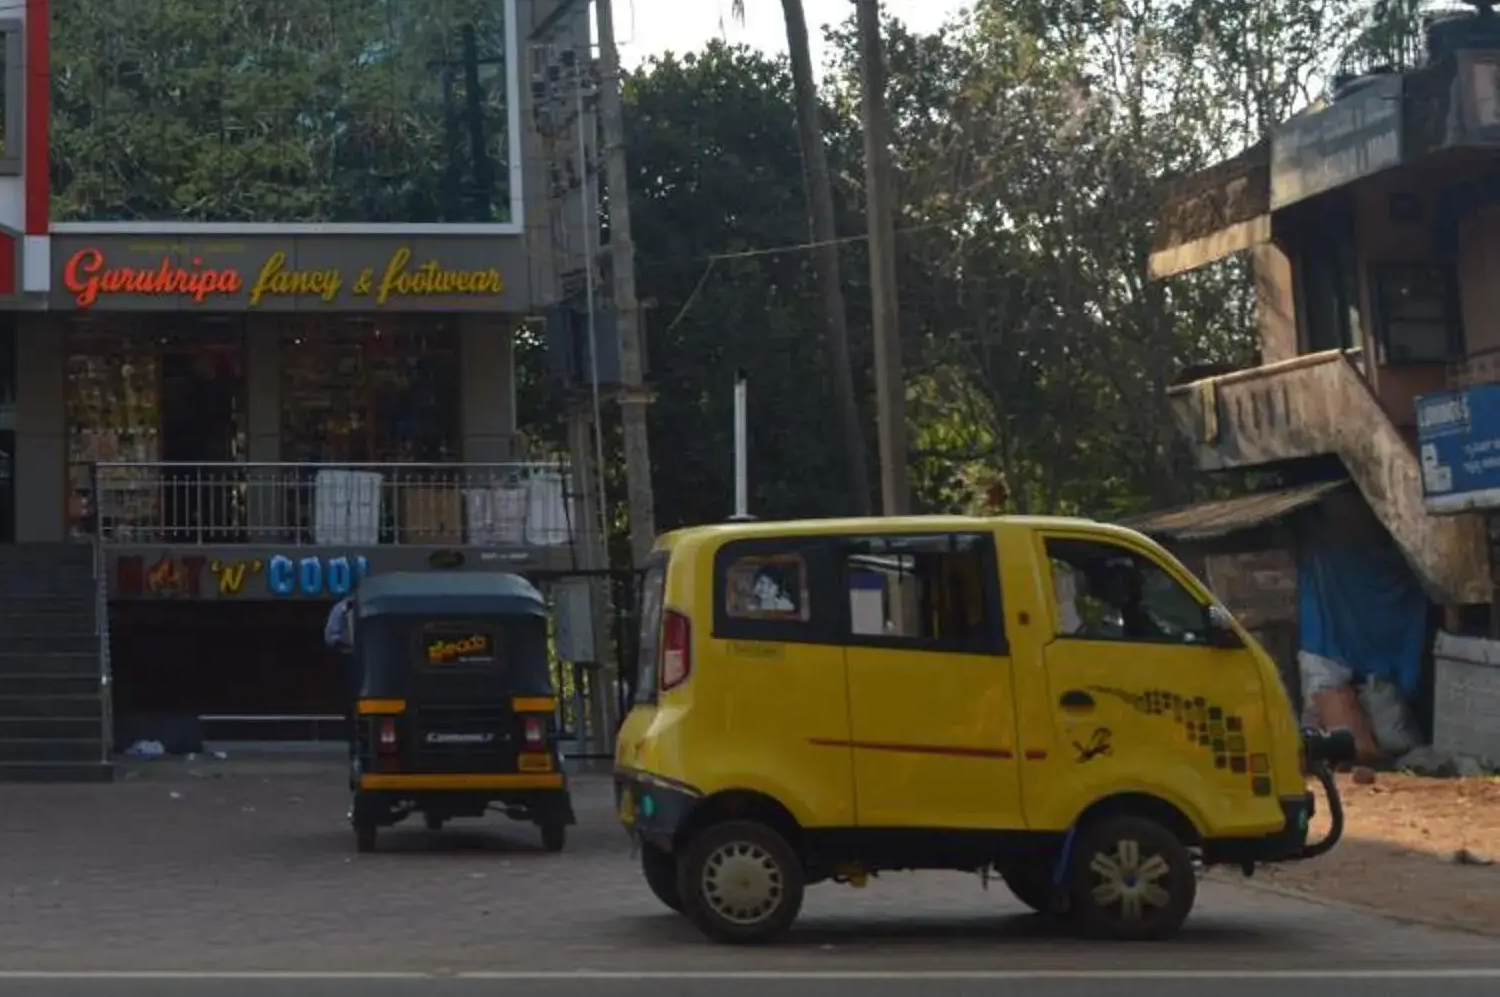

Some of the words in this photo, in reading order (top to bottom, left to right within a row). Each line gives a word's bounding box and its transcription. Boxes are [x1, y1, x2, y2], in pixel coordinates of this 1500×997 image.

[63, 248, 242, 305] Gurukripa
[248, 250, 341, 306] fancy
[352, 267, 373, 294] &
[376, 247, 506, 305] footwear
